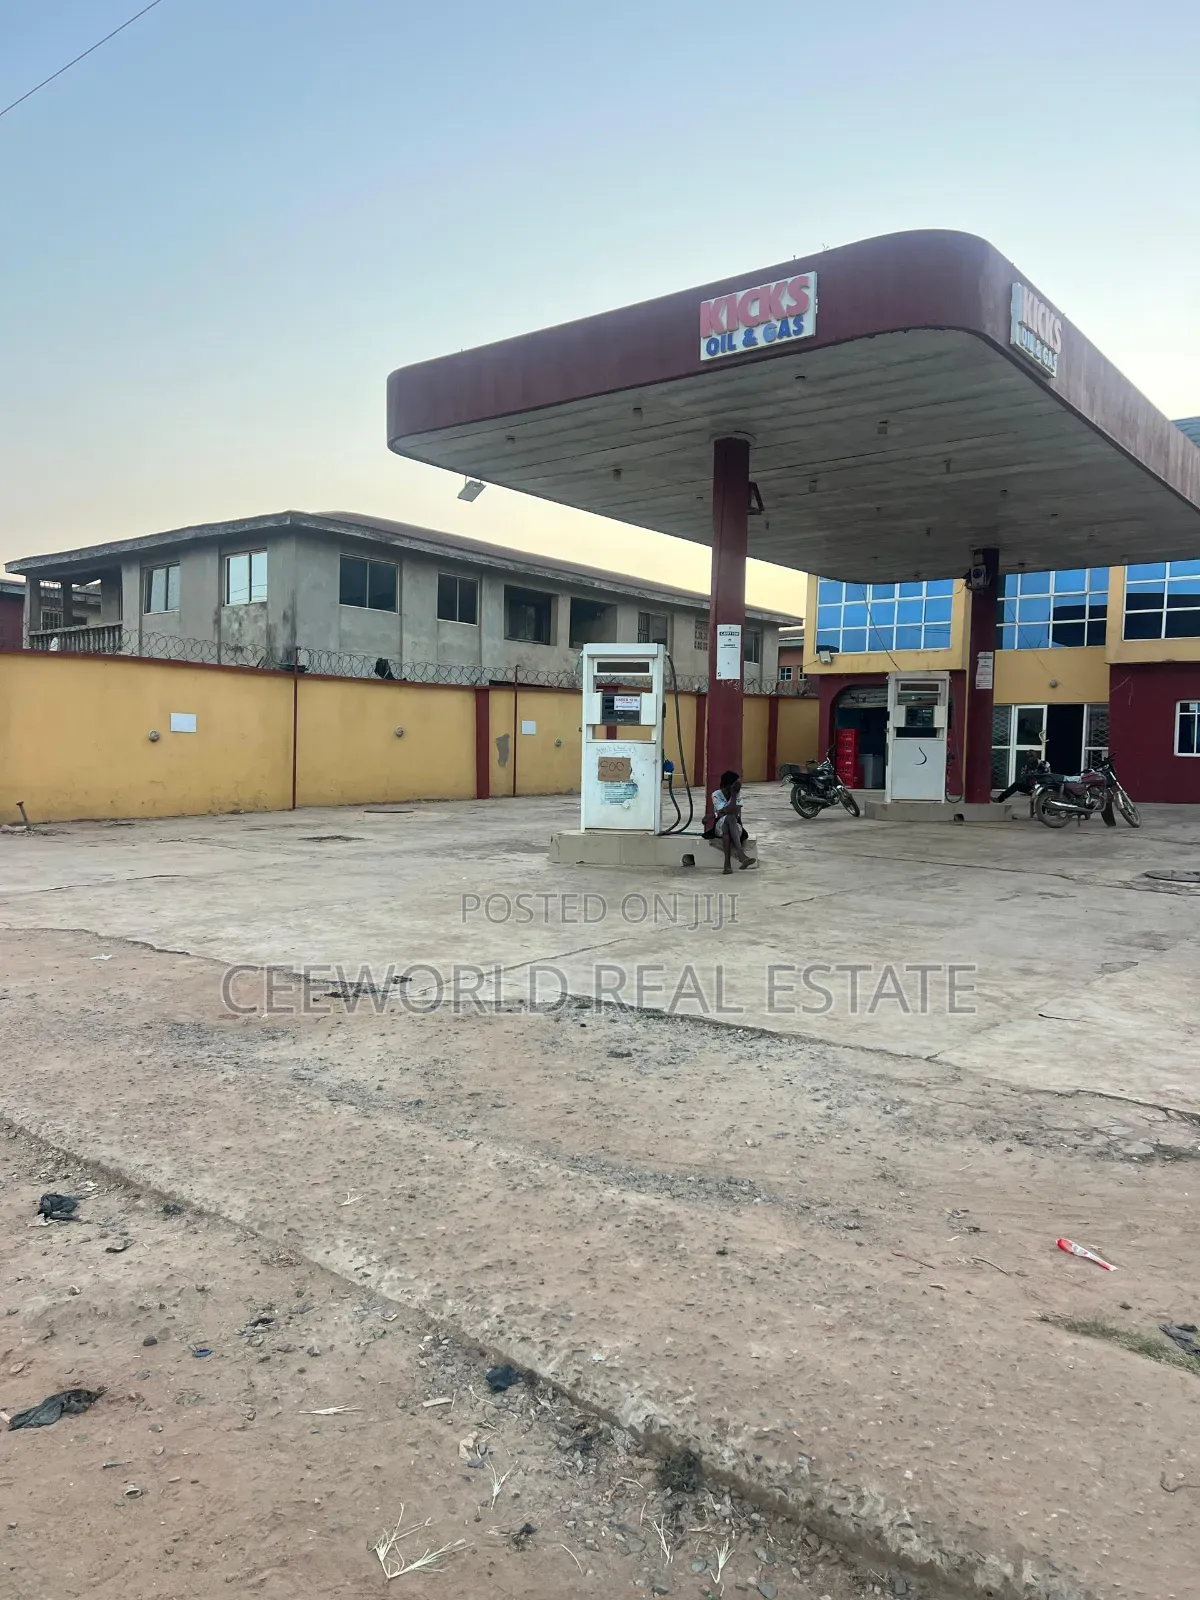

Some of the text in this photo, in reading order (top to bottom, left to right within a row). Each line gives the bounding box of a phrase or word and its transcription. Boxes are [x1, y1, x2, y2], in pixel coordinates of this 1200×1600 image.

[700, 275, 811, 339] KICKS
[706, 315, 805, 357] OIL & GAS
[1021, 284, 1062, 354] KICKS
